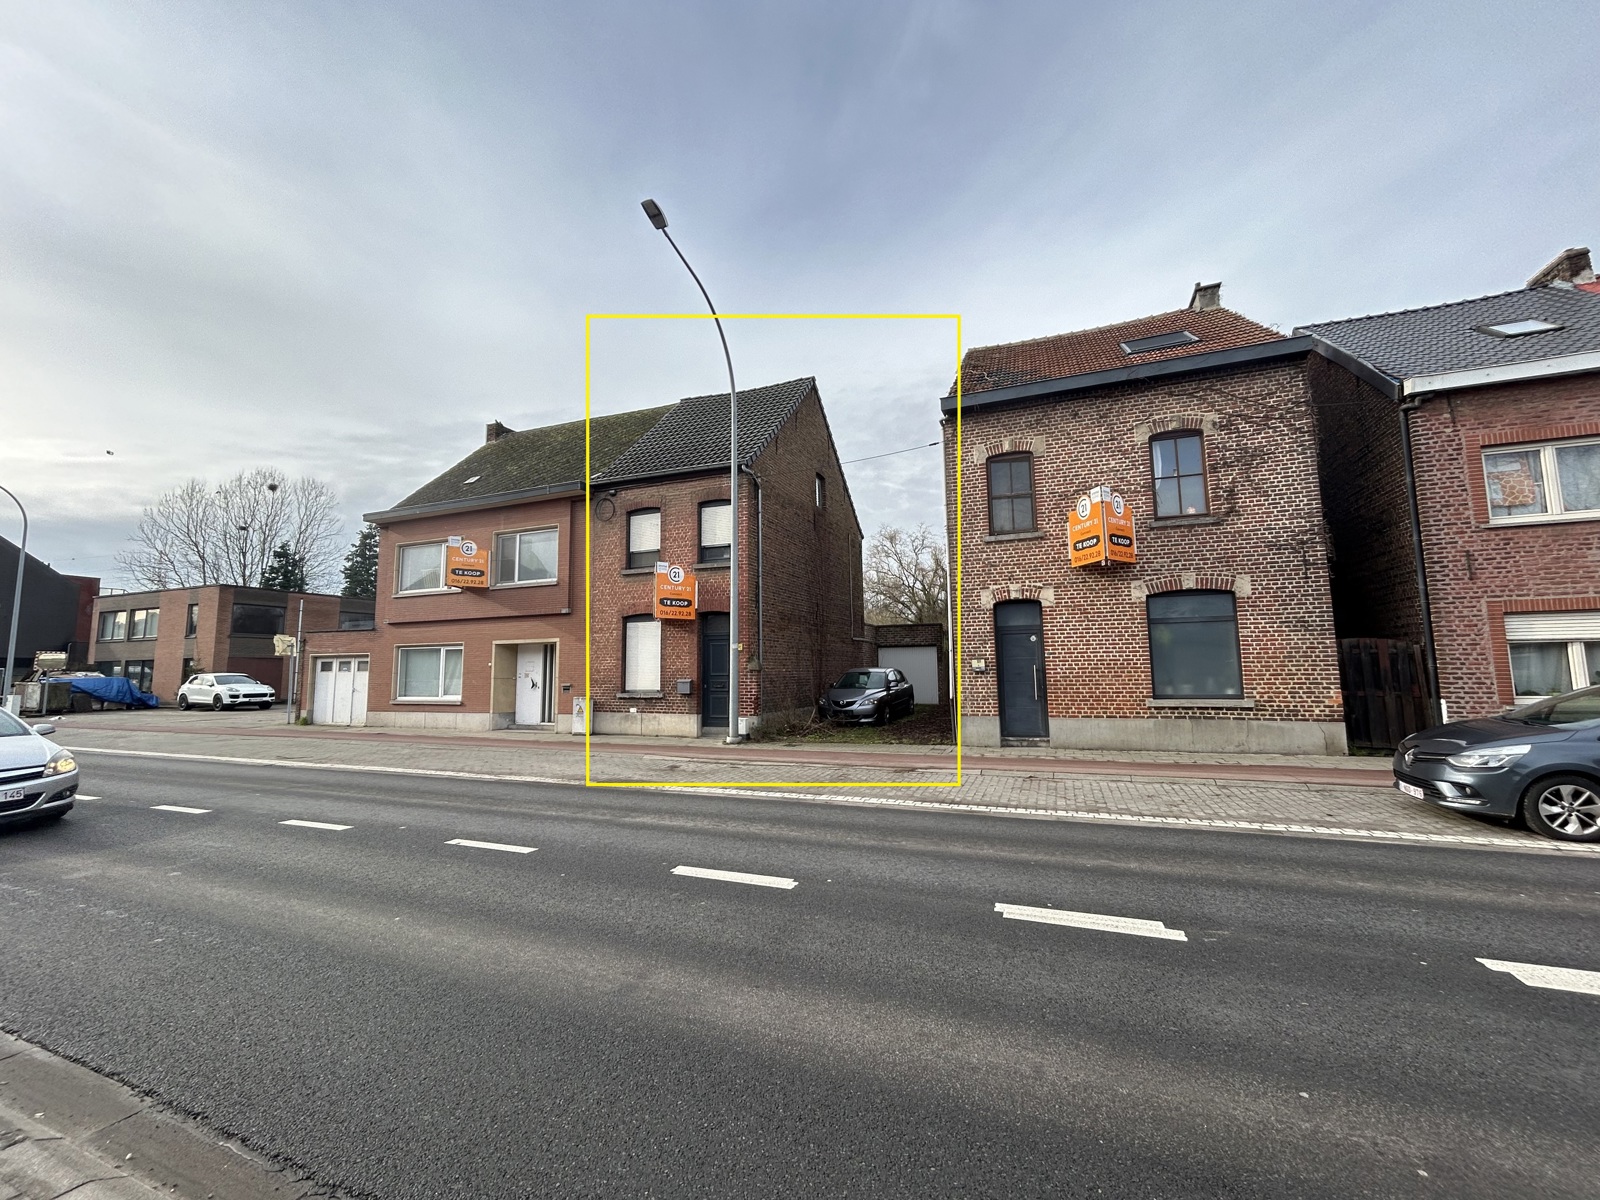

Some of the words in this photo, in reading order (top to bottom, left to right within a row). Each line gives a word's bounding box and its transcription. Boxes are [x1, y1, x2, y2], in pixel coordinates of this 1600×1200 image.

[1072, 520, 1093, 531] CENTURY
[1108, 517, 1126, 526] CENTURY
[1083, 538, 1097, 548] KOOP
[4, 790, 22, 799] 145
